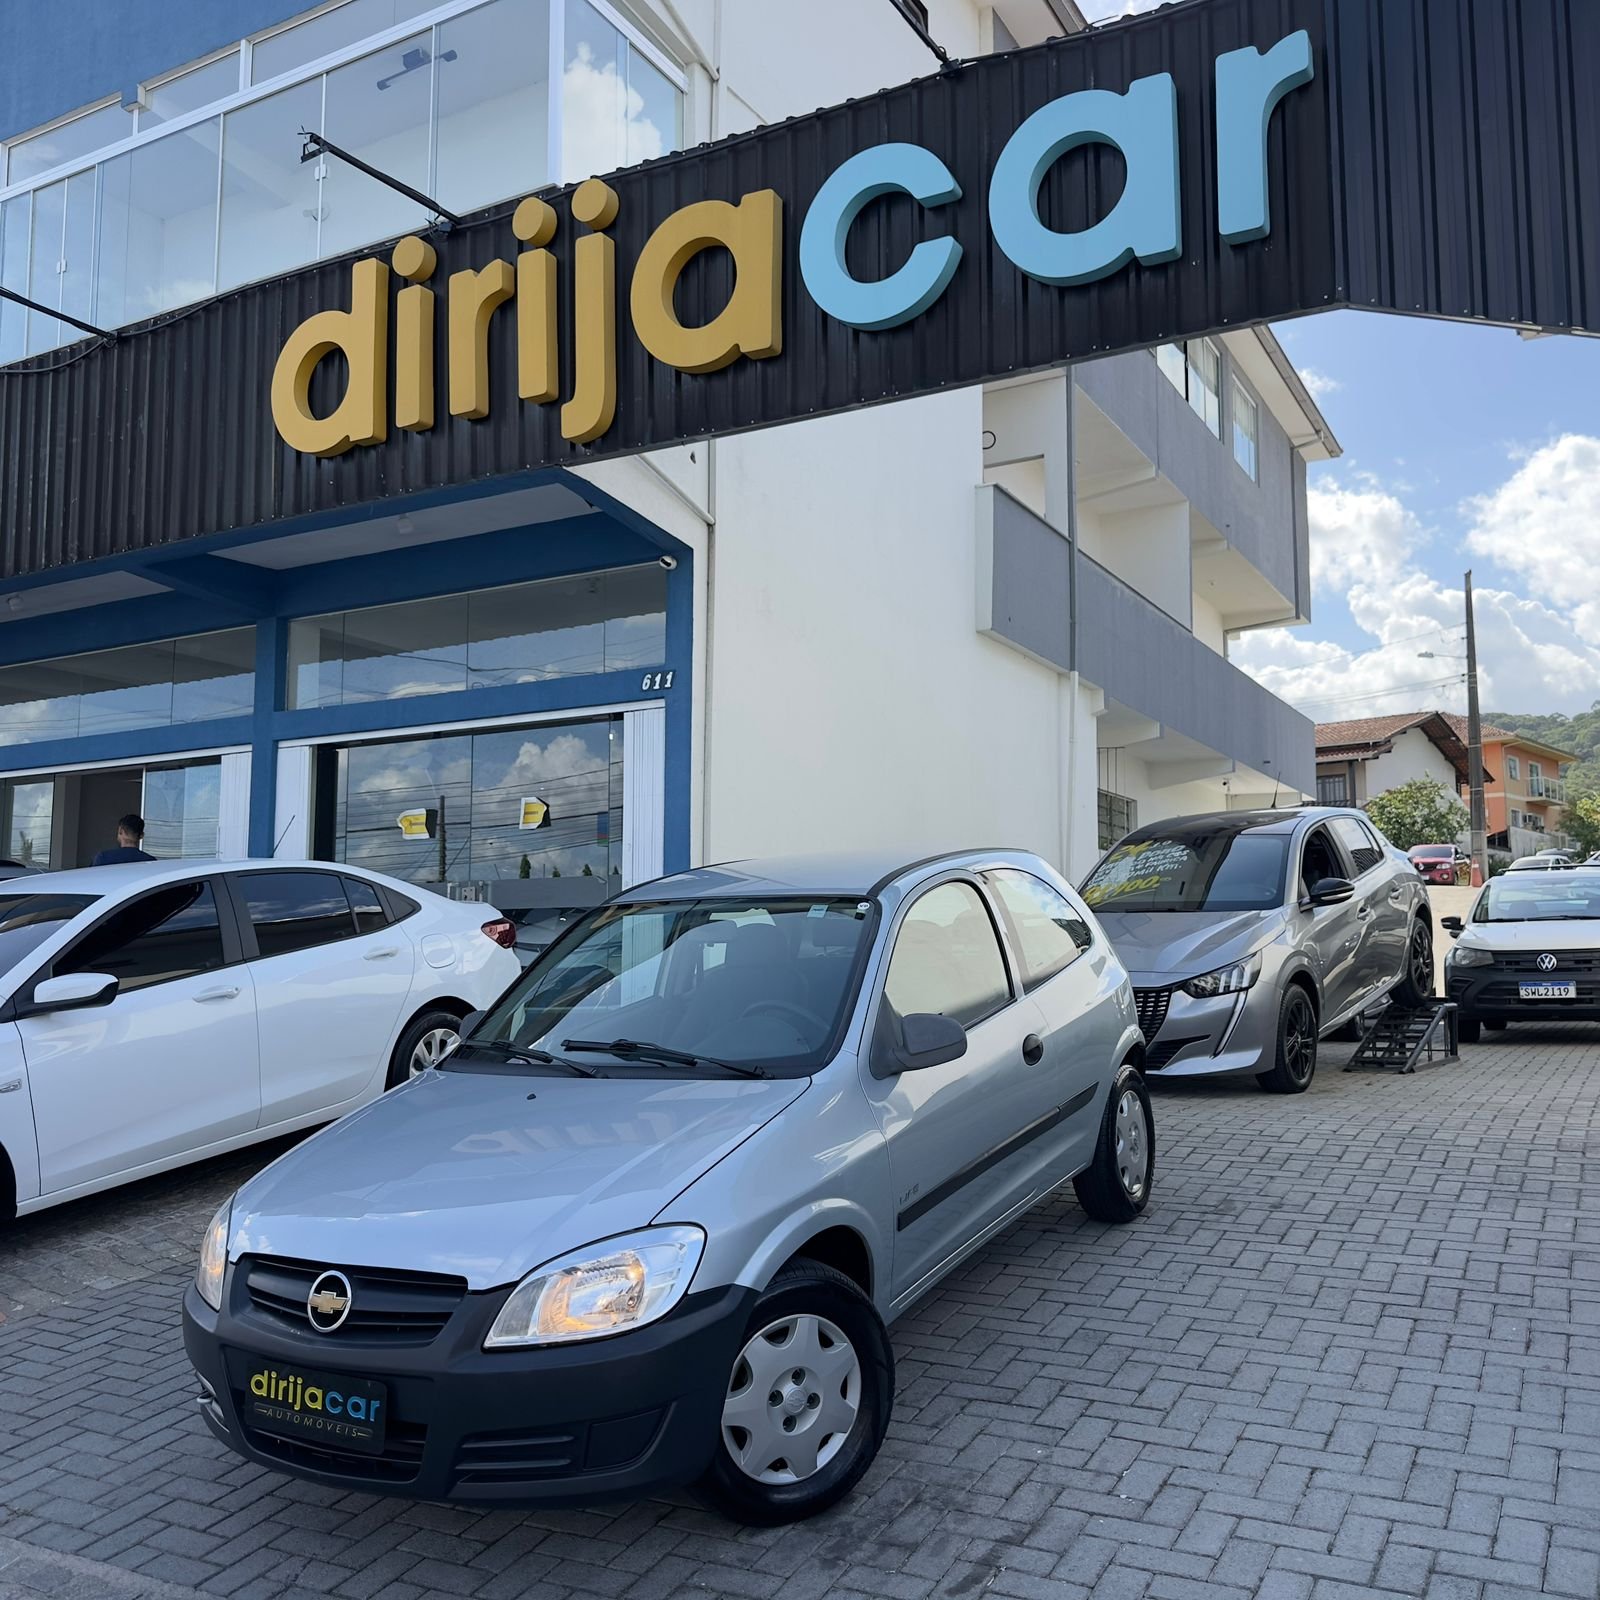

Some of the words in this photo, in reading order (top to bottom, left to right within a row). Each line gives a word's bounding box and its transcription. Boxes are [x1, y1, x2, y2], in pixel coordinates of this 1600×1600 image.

[270, 29, 1314, 458] dirijacar
[642, 671, 673, 690] 611
[1524, 987, 1570, 997] SWL2119
[250, 1369, 381, 1422] dirijacar
[266, 1408, 359, 1438] AUTOMÓVEIS
